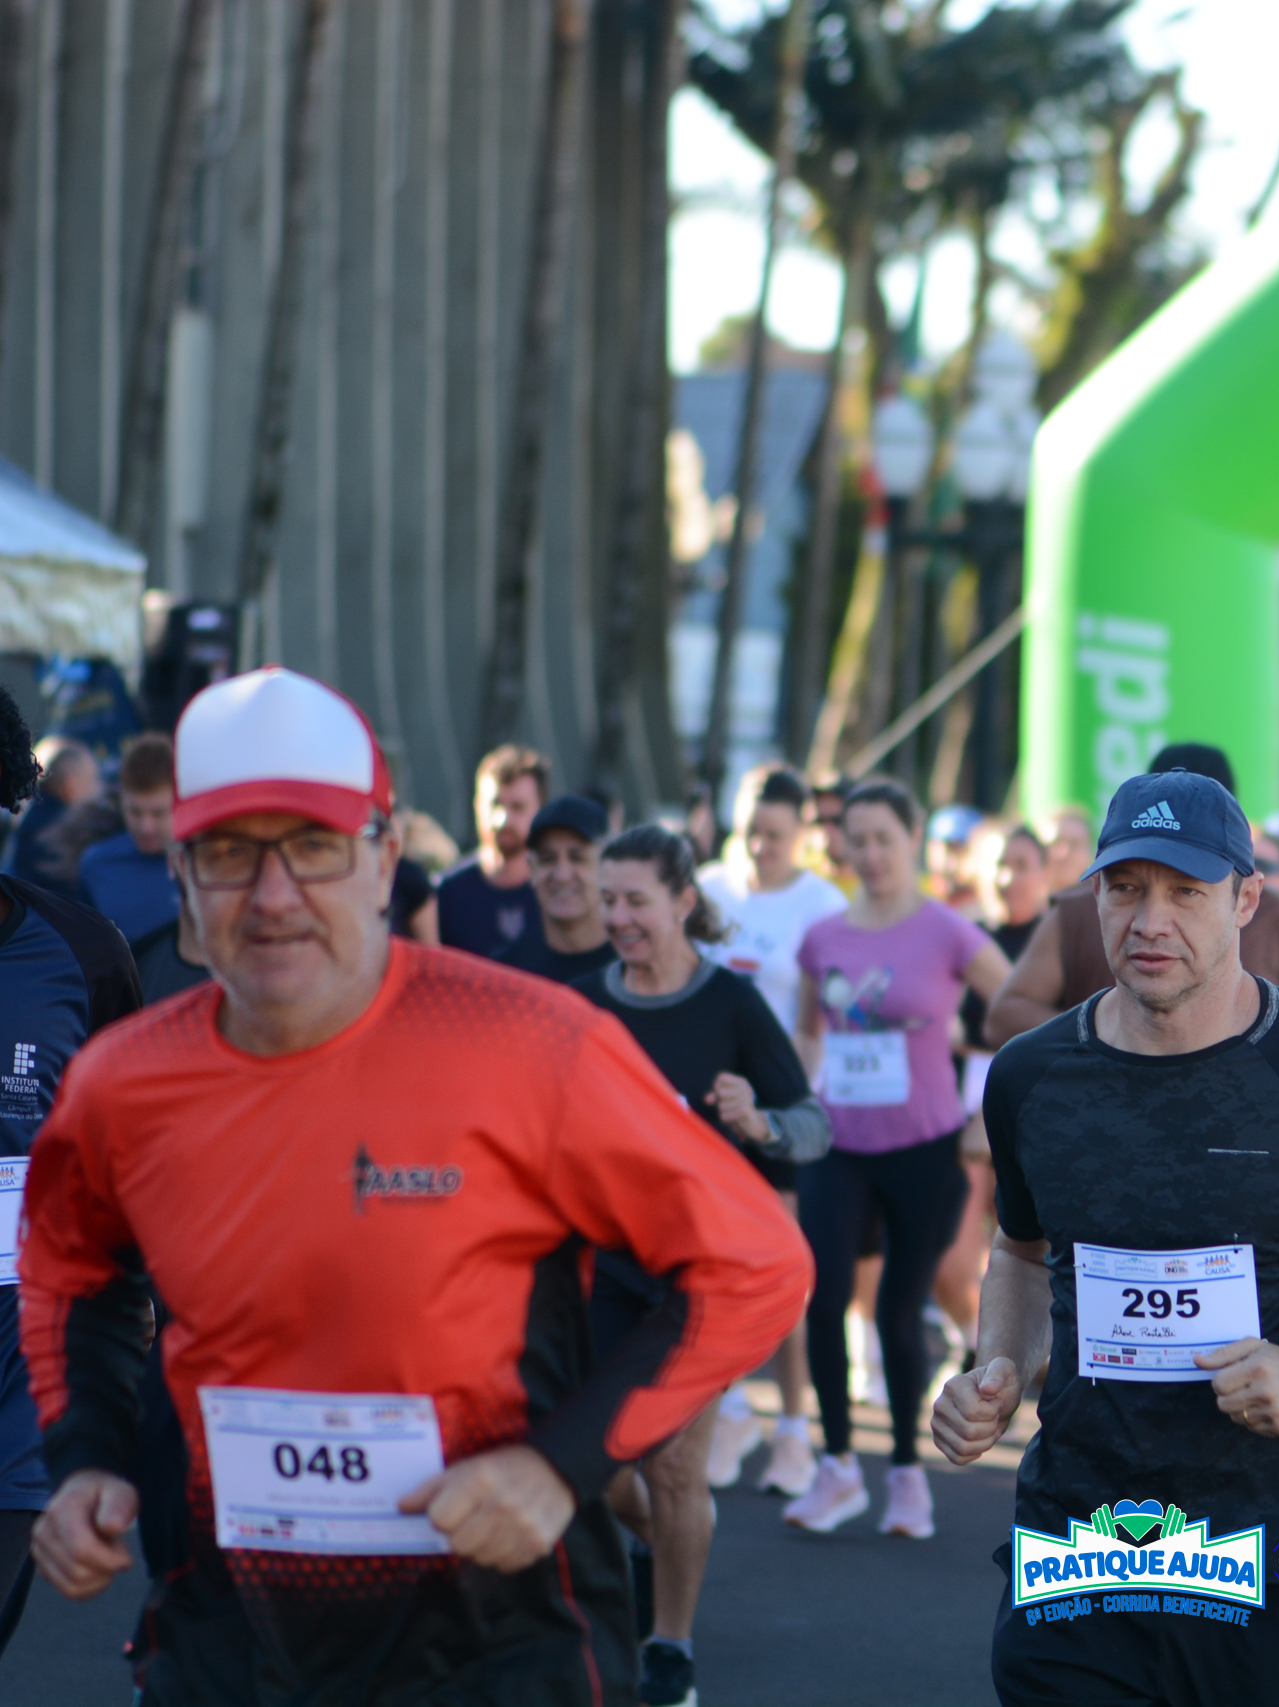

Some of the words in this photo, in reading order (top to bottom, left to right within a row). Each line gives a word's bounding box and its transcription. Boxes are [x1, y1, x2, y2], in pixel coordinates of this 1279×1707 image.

[1131, 816, 1181, 831] adidas
[4, 1084, 37, 1094] FEDERAL
[1205, 1266, 1231, 1276] CAUSA
[1121, 1287, 1201, 1319] 295
[272, 1442, 370, 1483] 048
